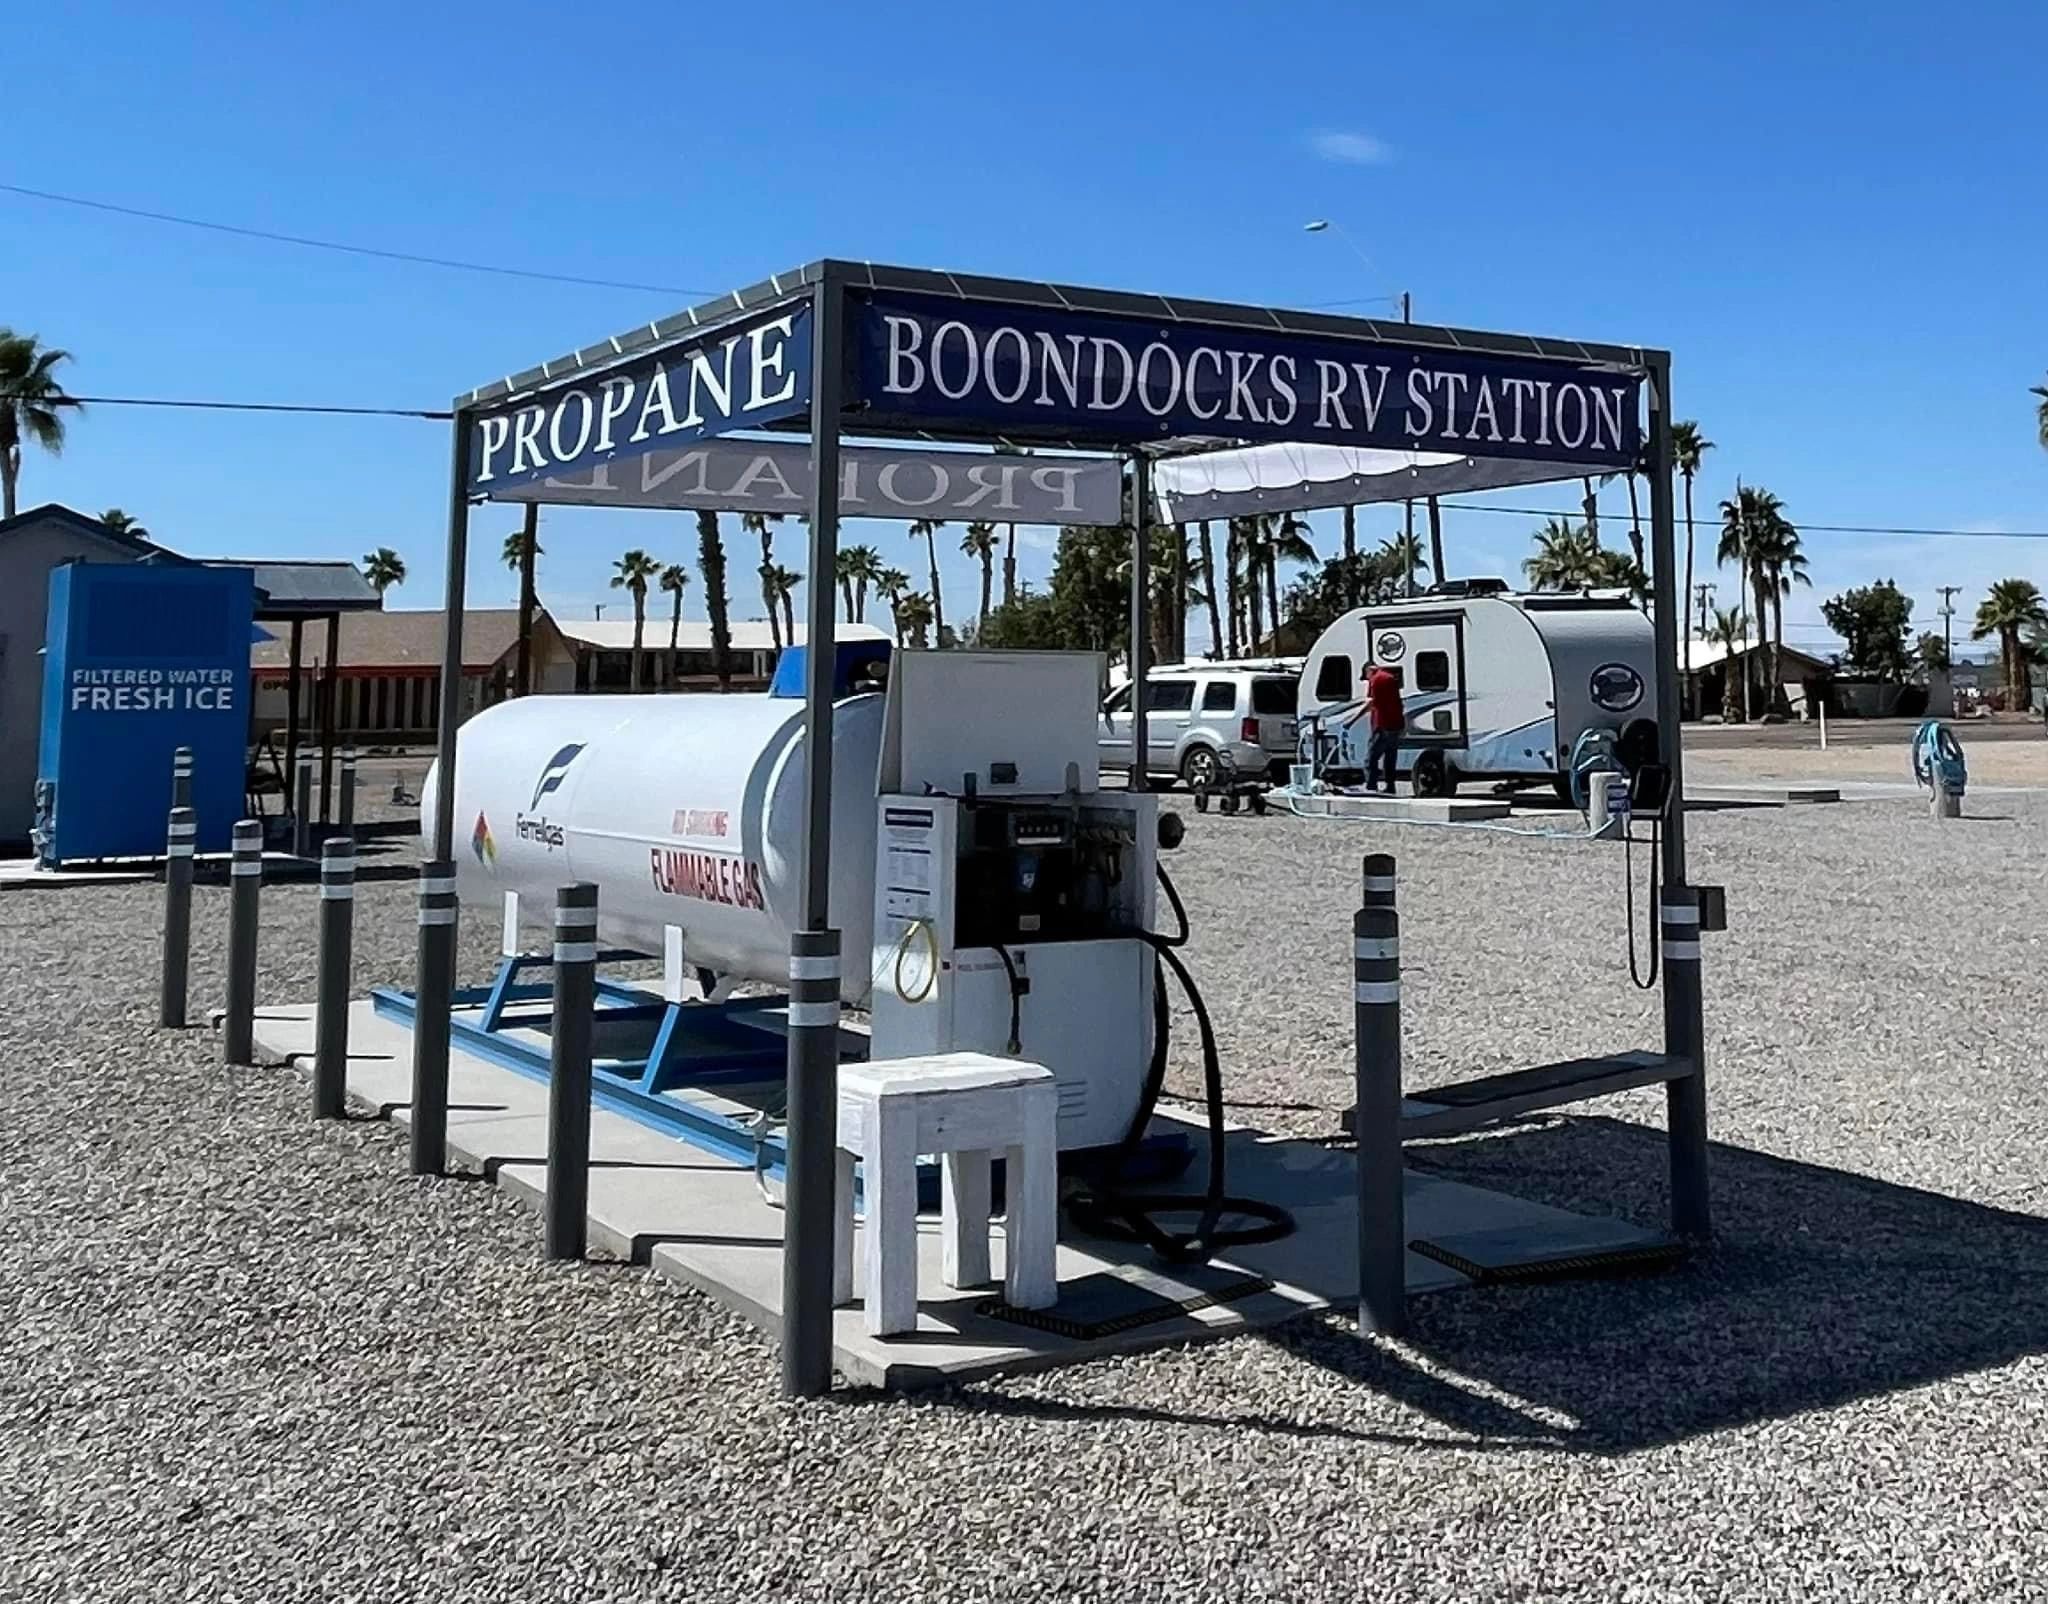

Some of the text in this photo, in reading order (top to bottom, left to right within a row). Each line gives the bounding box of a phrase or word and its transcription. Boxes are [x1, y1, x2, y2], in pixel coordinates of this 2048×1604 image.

[475, 314, 797, 484] PROPANE
[881, 314, 1626, 451] BOONDOCKS RV STATION
[71, 687, 233, 711] FRESH ICE
[72, 669, 234, 684] FILTERED WATER
[651, 848, 765, 911] FLAMMABLE GAS
